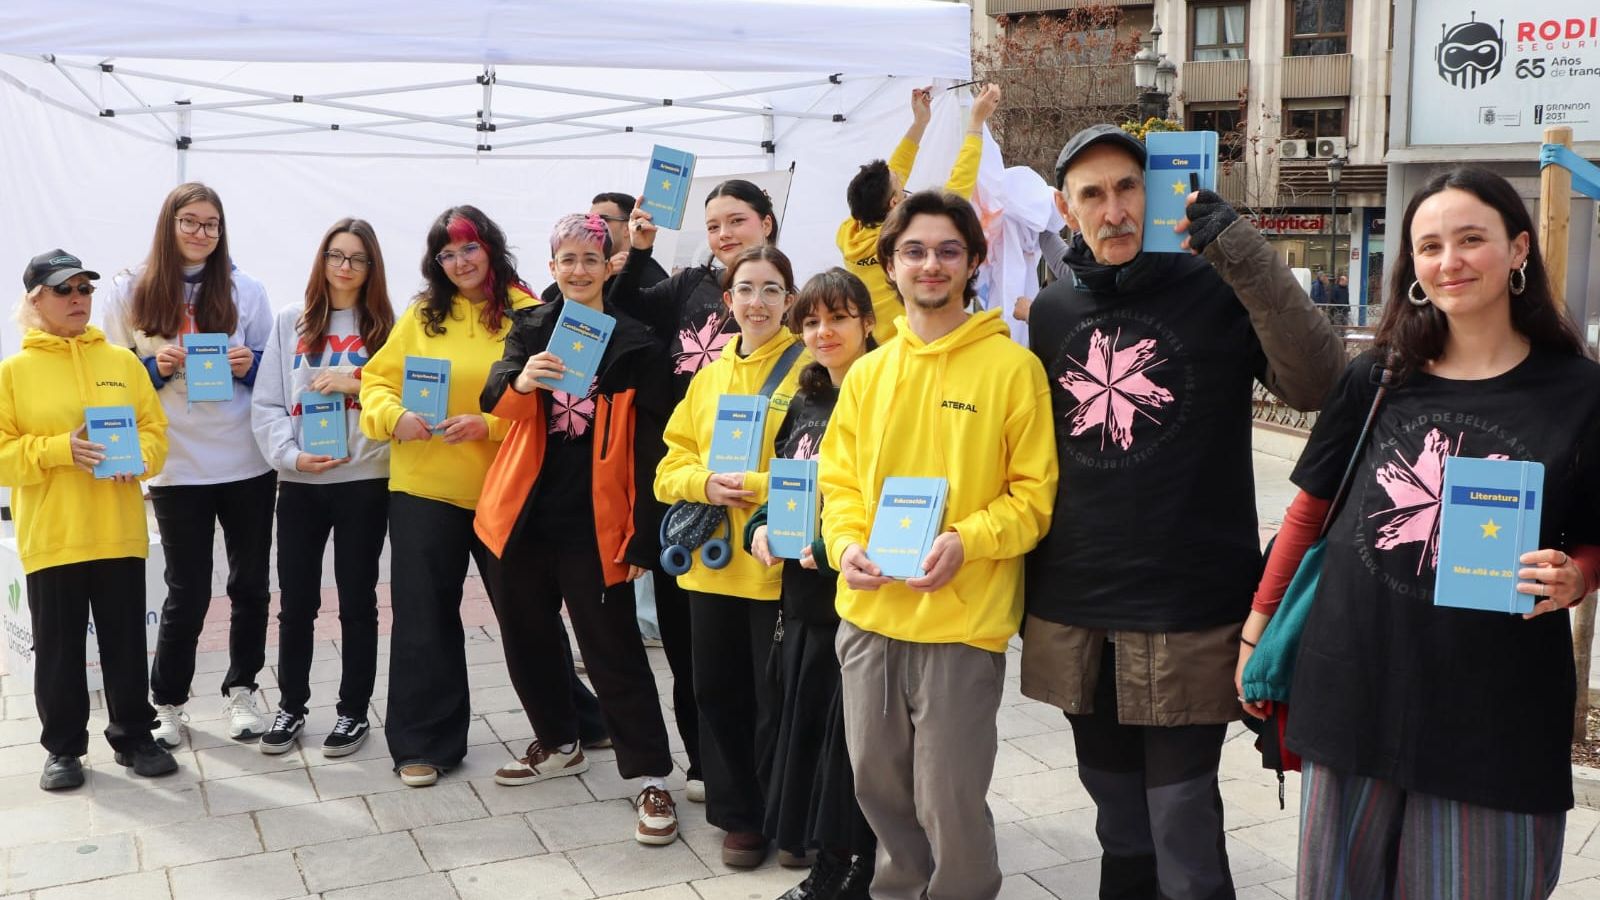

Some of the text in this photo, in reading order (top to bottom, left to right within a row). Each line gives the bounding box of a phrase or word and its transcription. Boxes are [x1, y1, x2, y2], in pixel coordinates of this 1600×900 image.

[1517, 17, 1597, 42] RODI
[1517, 40, 1597, 52] SEGURI
[1552, 56, 1581, 66] Años
[1515, 58, 1545, 79] 65
[1551, 67, 1600, 78] de tranq
[1546, 112, 1565, 120] 2031
[1172, 158, 1188, 167] Cine
[1250, 213, 1325, 233] oloptical
[95, 381, 128, 389] LATERAL
[941, 400, 978, 413] ATERAL
[1431, 412, 1451, 423] DE
[1469, 491, 1519, 503] Literatura
[1501, 569, 1513, 578] 20
[1380, 572, 1432, 601] EYOND
